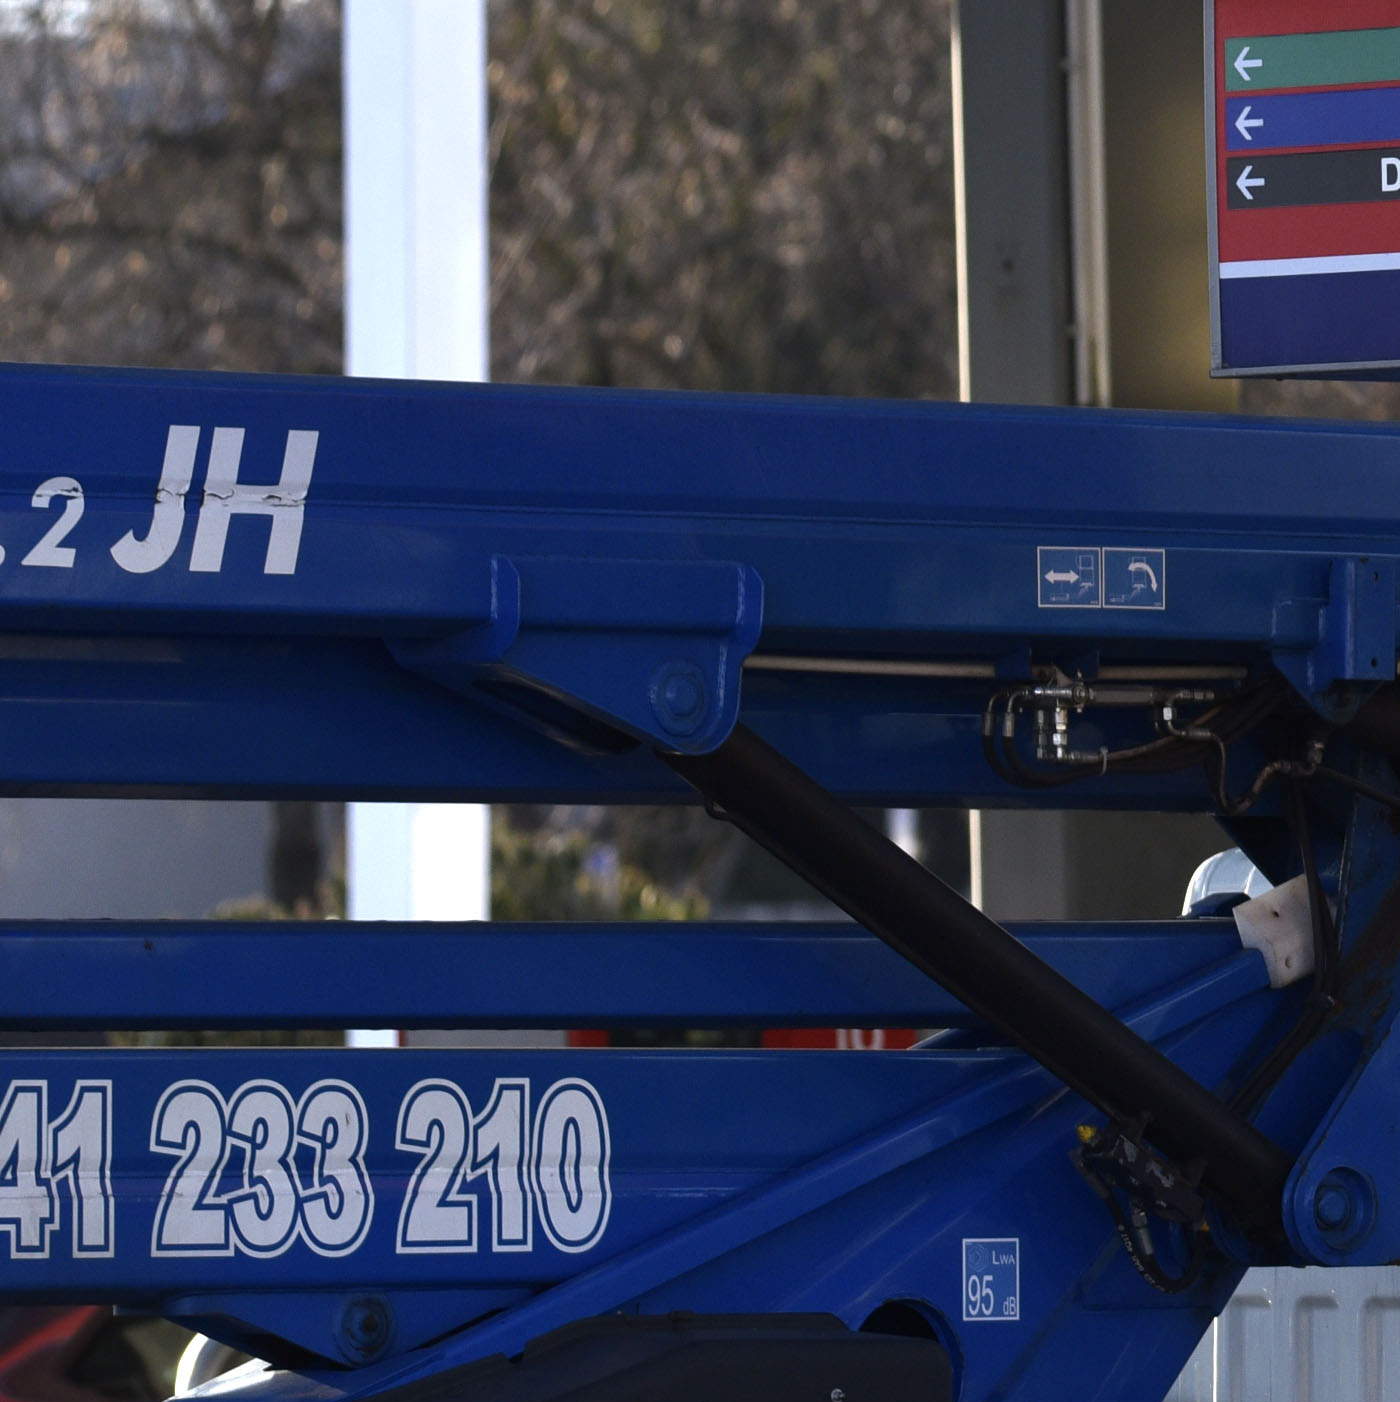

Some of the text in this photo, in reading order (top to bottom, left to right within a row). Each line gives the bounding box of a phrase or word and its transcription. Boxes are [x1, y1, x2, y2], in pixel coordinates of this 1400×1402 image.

[110, 424, 319, 574] JH
[0, 1077, 611, 1258] 41 233 210
[968, 1274, 994, 1315] 95
[1003, 1296, 1017, 1315] dB
